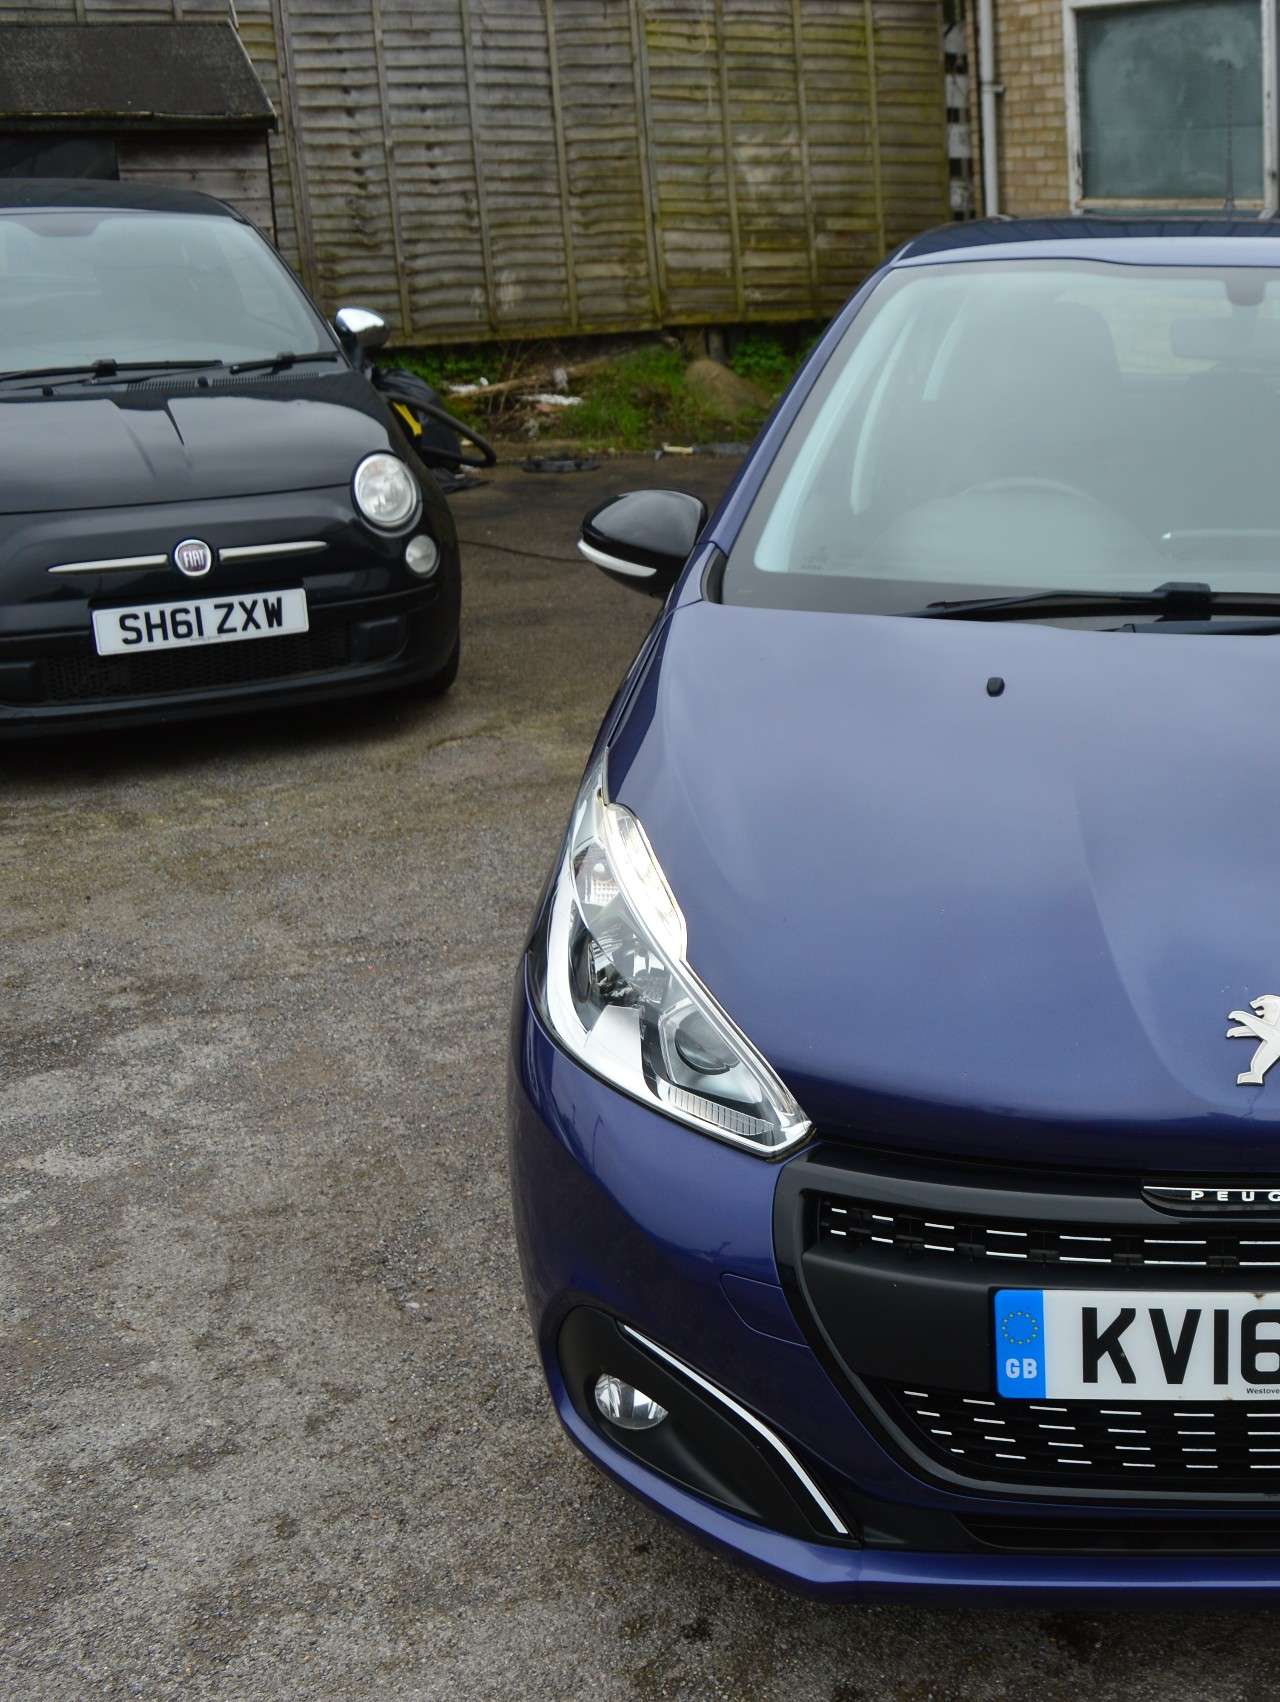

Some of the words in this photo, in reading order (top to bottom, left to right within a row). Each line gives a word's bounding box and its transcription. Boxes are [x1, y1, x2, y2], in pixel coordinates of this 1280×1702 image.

[182, 550, 206, 569] FIAT
[119, 606, 204, 646] SH61
[214, 597, 283, 636] ZXW
[1005, 1358, 1038, 1379] GB
